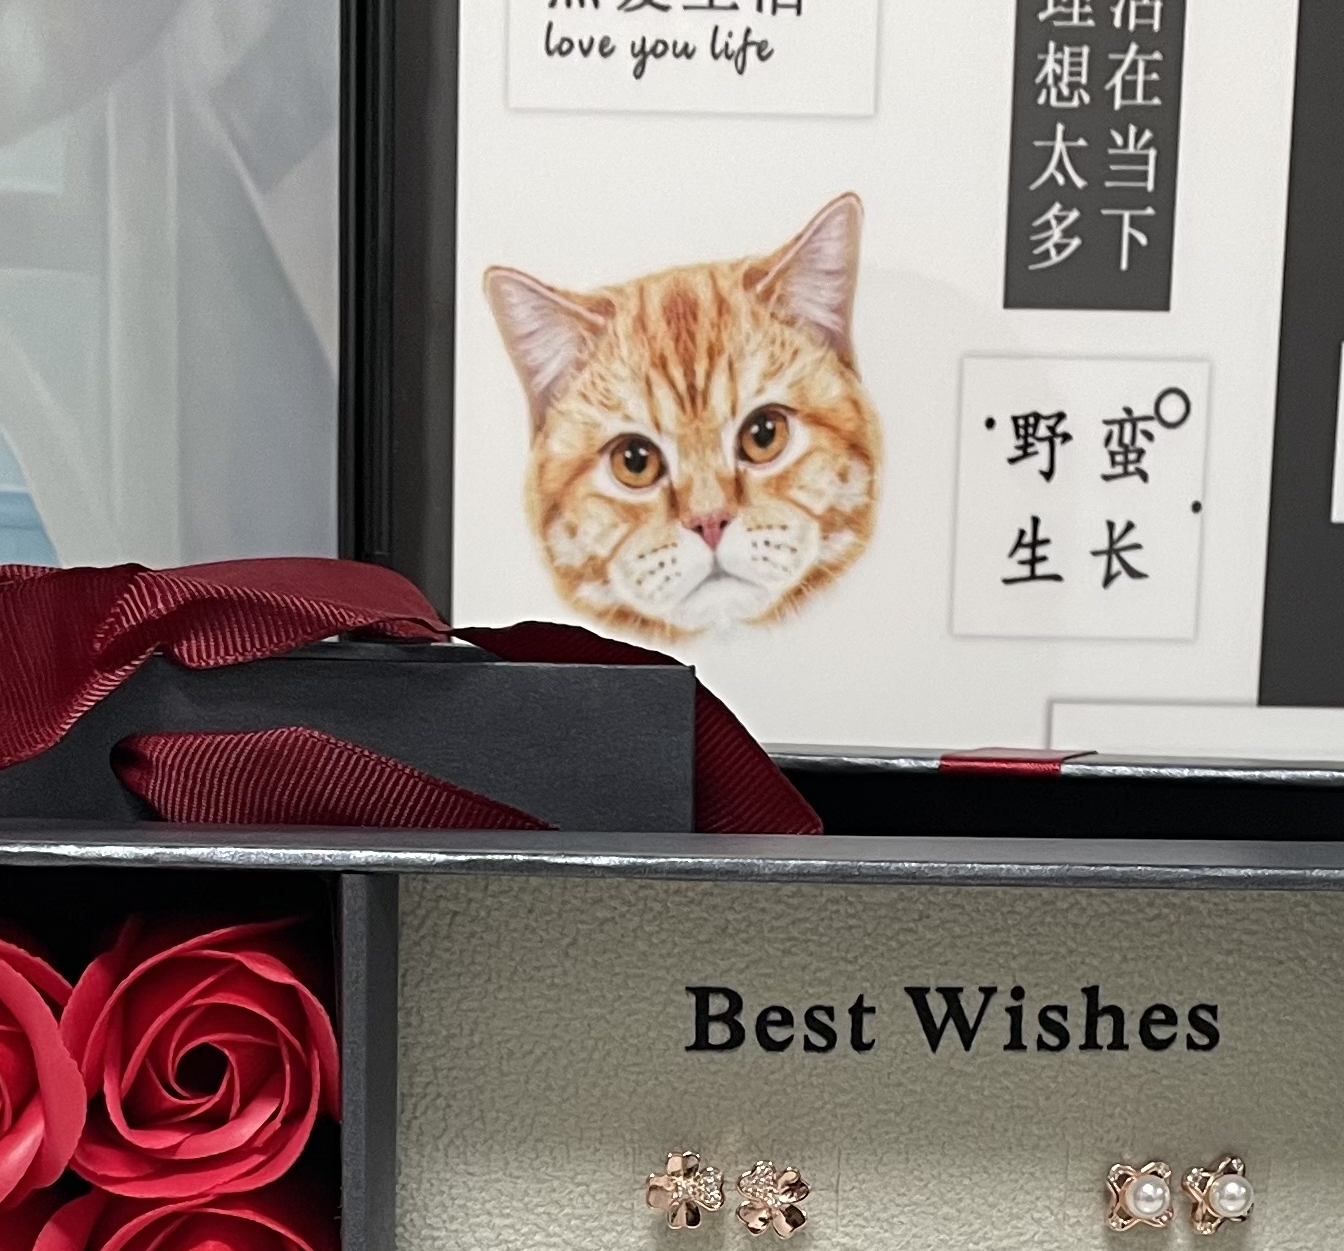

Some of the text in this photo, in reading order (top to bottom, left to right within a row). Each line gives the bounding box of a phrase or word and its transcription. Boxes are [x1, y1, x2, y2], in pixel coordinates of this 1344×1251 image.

[544, 20, 775, 80] love you life
[1005, 406, 1156, 485] 野蛮
[1001, 515, 1149, 590] 生长
[684, 984, 1221, 1054] Best Wishes
